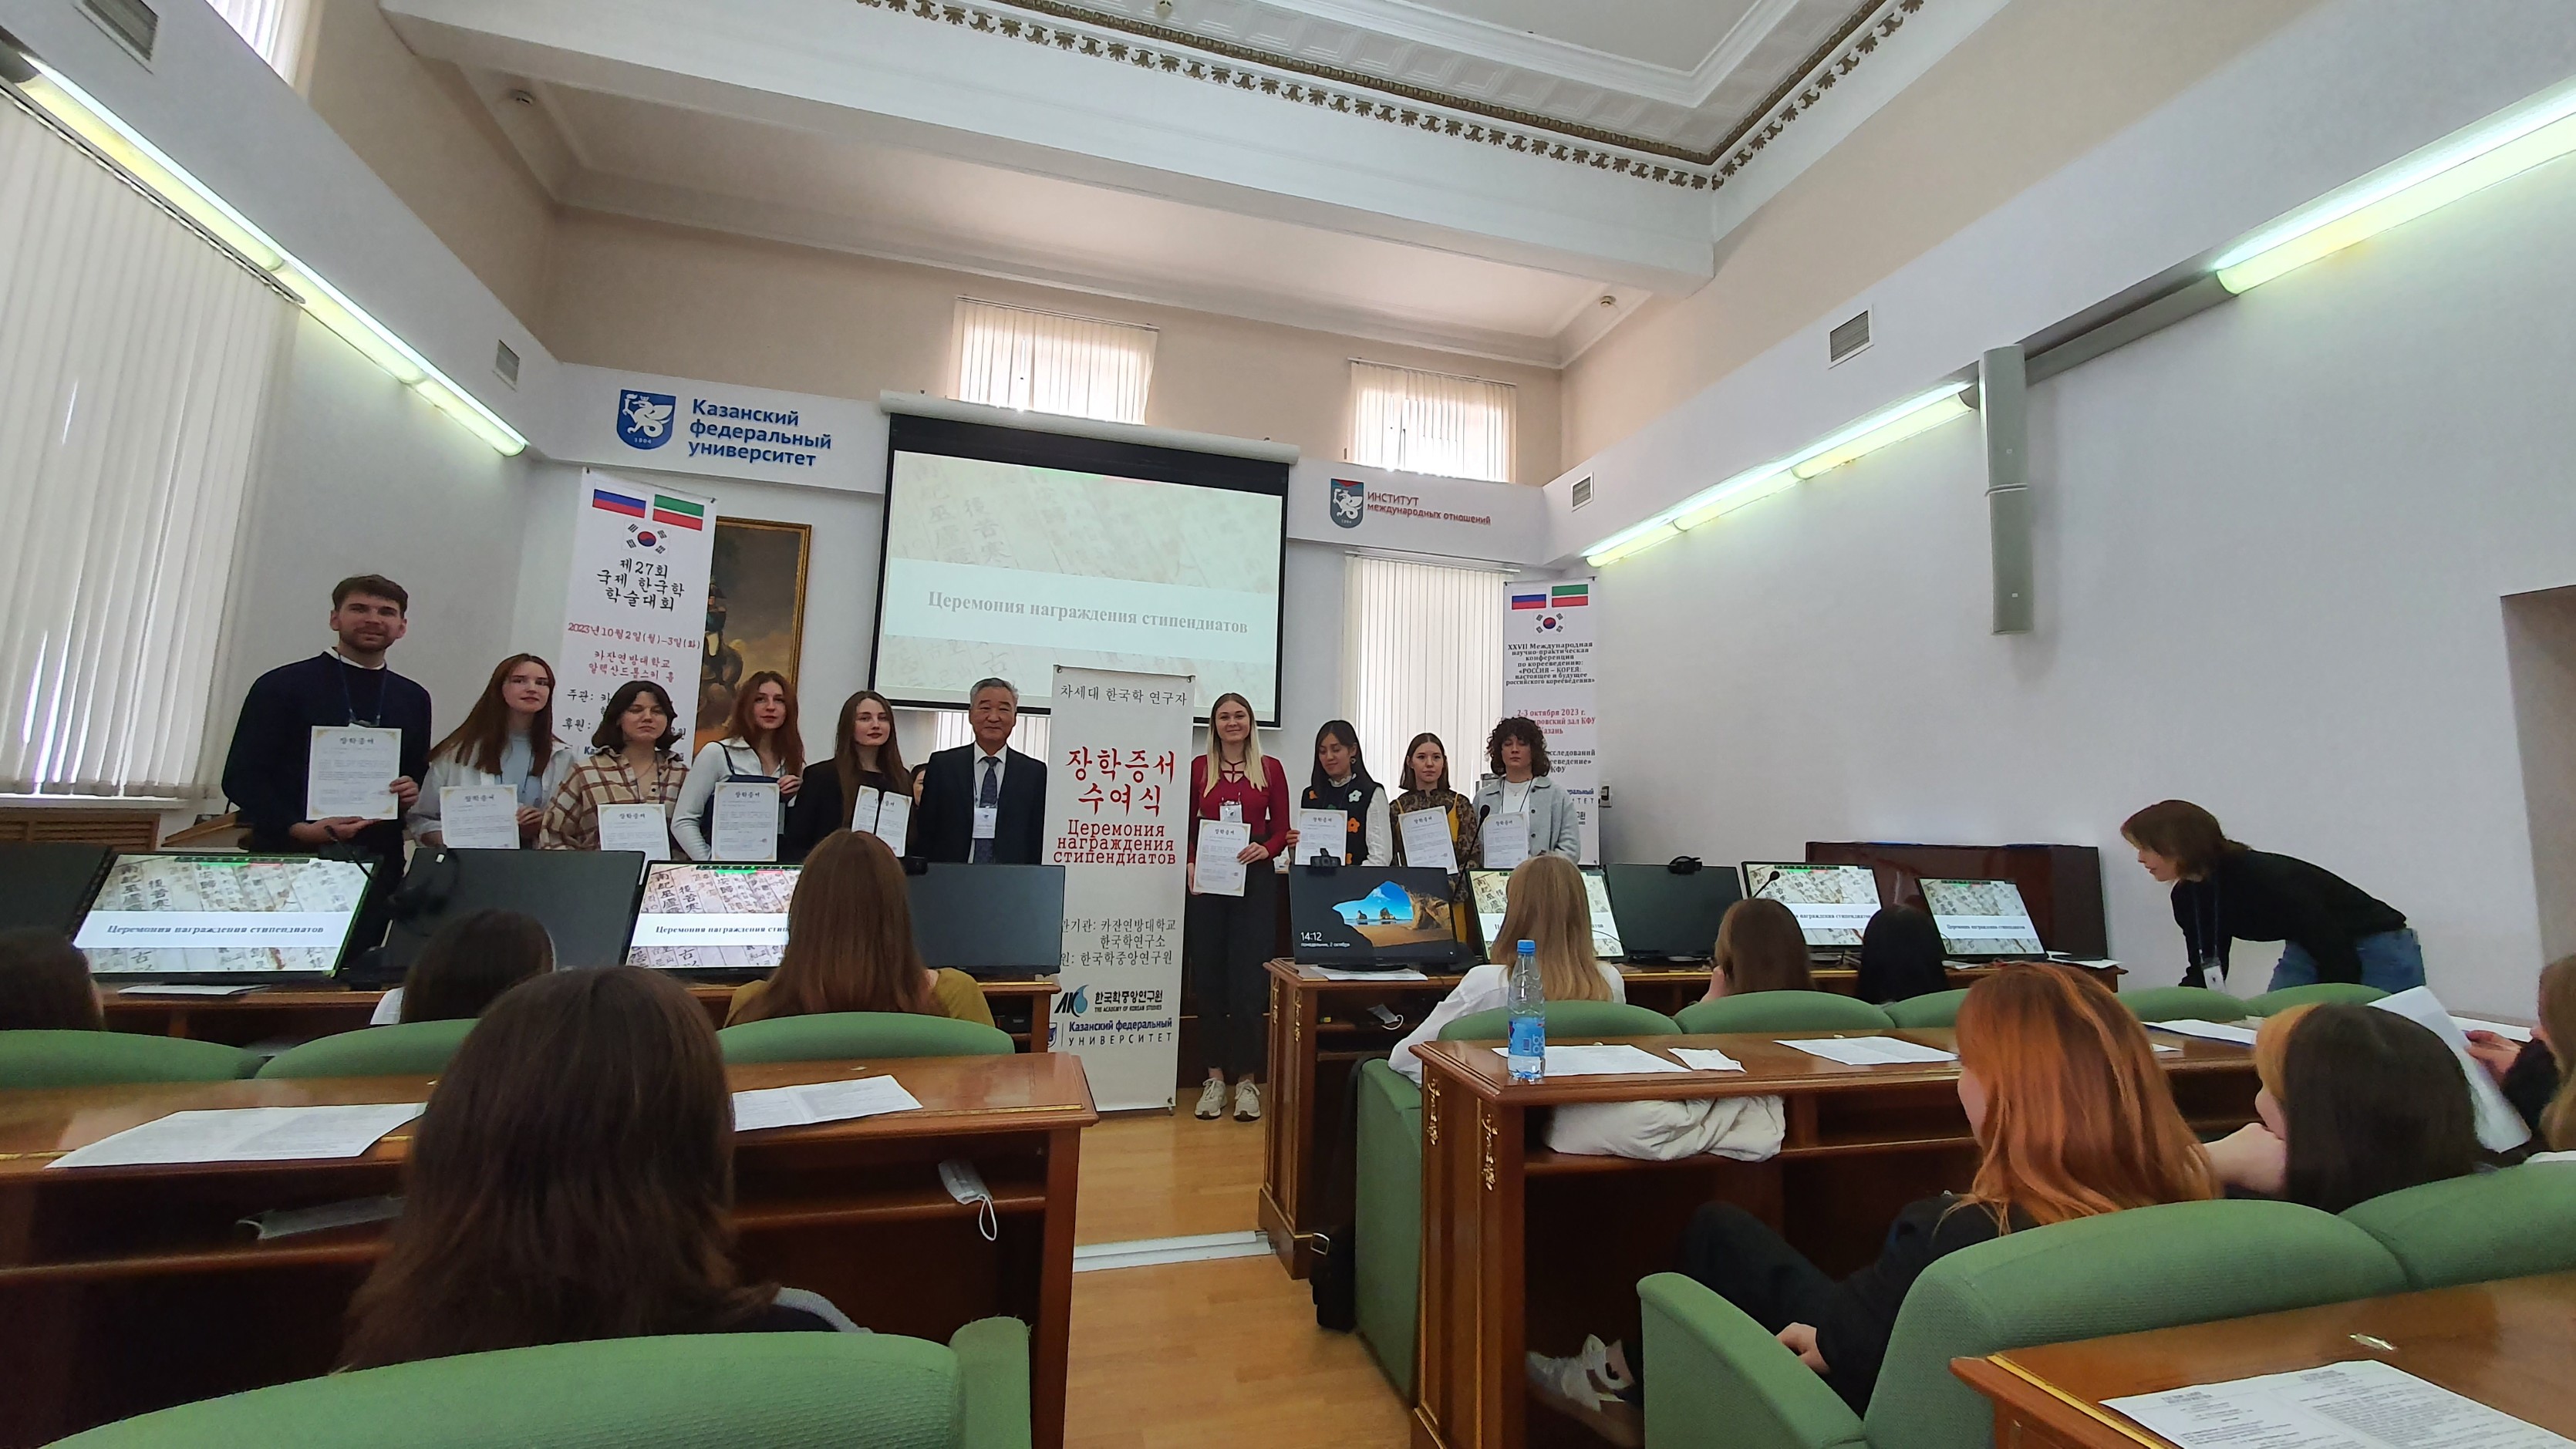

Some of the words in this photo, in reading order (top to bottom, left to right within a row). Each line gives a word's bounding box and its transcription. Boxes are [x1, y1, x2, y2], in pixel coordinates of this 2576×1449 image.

[693, 399, 799, 426] Казанский
[690, 419, 832, 450] федеральный
[688, 440, 816, 467] университет
[1367, 491, 1419, 507] ИНСТИТУТ
[1367, 504, 1441, 519] международных
[1443, 512, 1491, 525] отношений
[619, 558, 668, 579] 제27회
[597, 569, 627, 588] 국제
[639, 577, 685, 598] 한국학
[605, 587, 674, 612] 학술대회
[928, 591, 1024, 615] Церемония
[1030, 602, 1138, 625] награждения
[1141, 612, 1249, 635] стипендиатов
[1060, 684, 1099, 701] 차세대
[1106, 687, 1145, 703] 한국학
[1150, 690, 1188, 706] 연구자
[1529, 709, 1559, 718] октября
[1065, 746, 1175, 784] 장학증서
[1078, 783, 1162, 817] 수여식
[1067, 819, 1165, 838] Церемония
[1057, 837, 1174, 853] награждения
[1054, 851, 1176, 866] стипендиатов
[107, 925, 171, 934] Церемония
[656, 925, 706, 934] Церемония
[1101, 918, 1175, 932] 카잔연방대학교
[1101, 934, 1165, 949] 한국학연구소
[1300, 932, 1322, 941] 14:12
[1061, 952, 1074, 966] 원:
[1081, 950, 1172, 966] 한국학중앙연구원
[1094, 989, 1163, 1005] 한국학중앙연구원
[1069, 1020, 1114, 1032] Казанский
[1116, 1017, 1172, 1033] федеральный
[1069, 1033, 1172, 1046] УНИВЕРСИТЕТ
